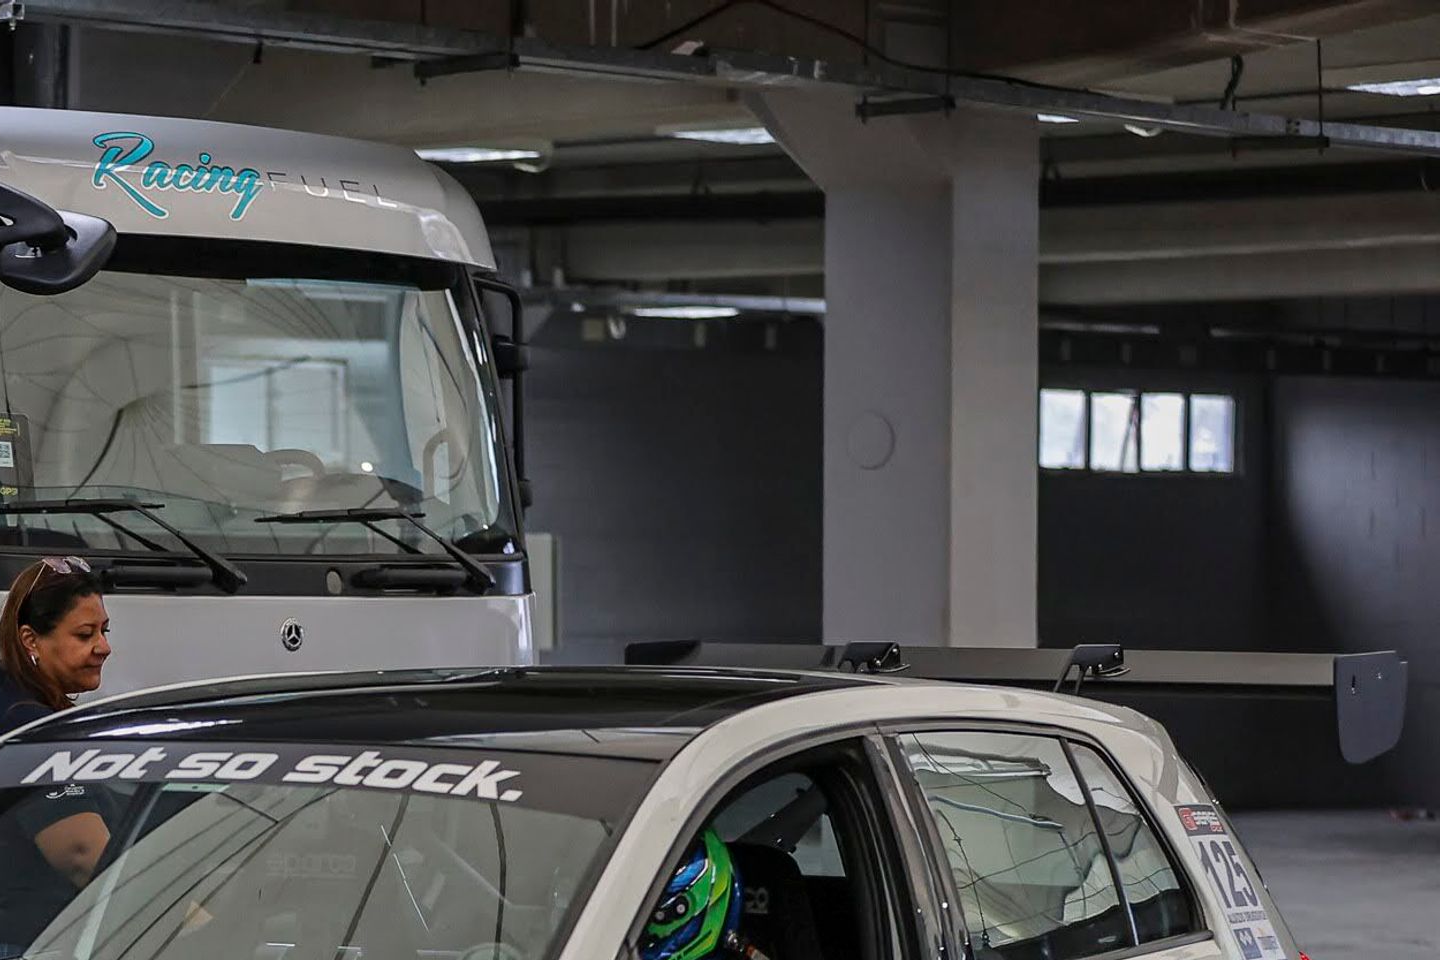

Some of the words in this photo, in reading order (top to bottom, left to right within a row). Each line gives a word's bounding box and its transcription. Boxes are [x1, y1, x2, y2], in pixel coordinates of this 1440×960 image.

[92, 131, 263, 220] Racing
[266, 171, 398, 207] FUEL
[20, 747, 165, 783] Not
[165, 752, 278, 781] so
[283, 750, 523, 801] stock.
[1198, 840, 1258, 908] 125
